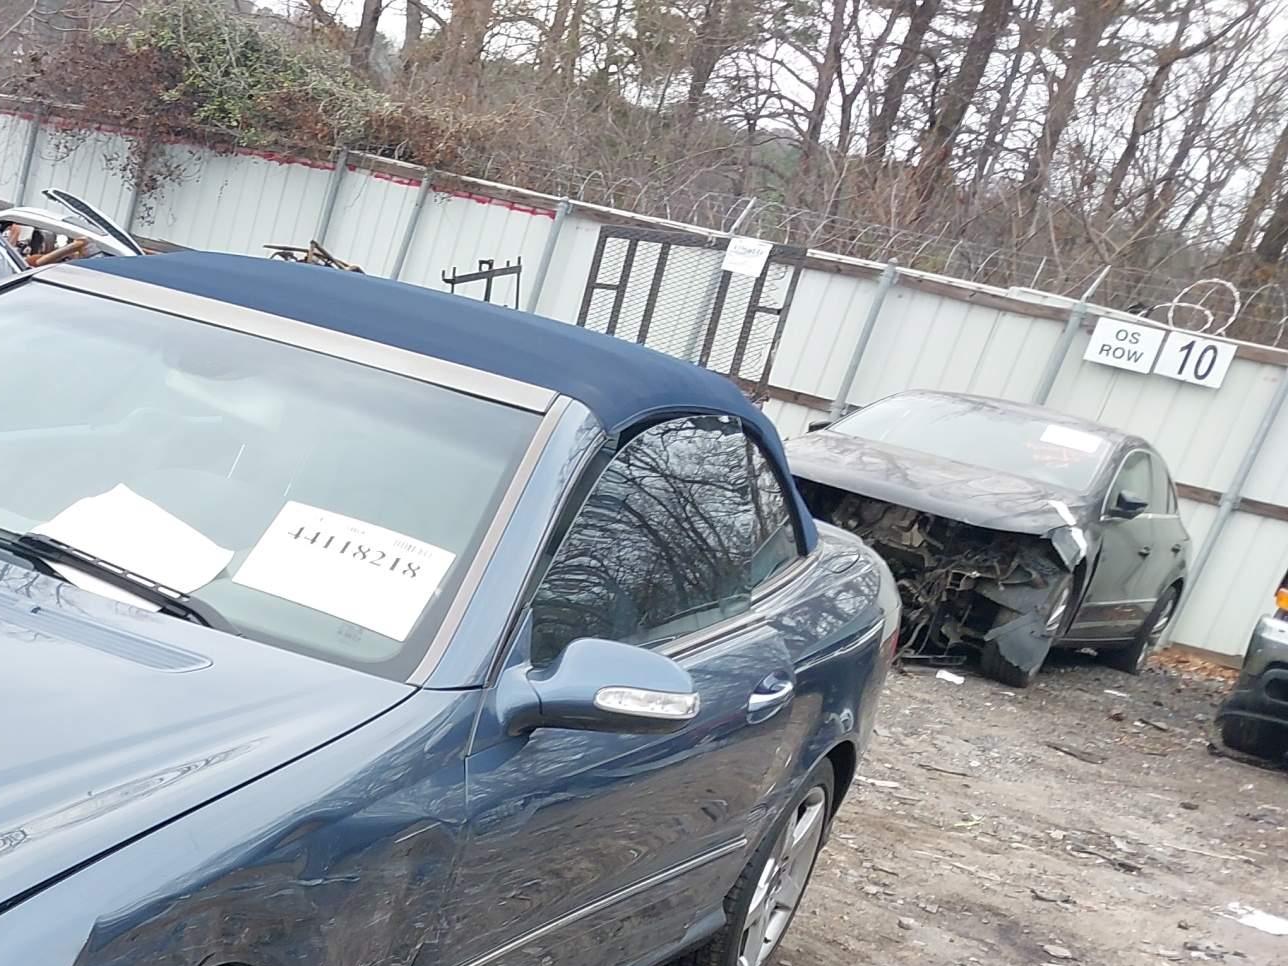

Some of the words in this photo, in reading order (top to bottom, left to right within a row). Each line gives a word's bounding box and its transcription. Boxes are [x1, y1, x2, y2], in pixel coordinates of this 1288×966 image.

[1115, 328, 1141, 345] OS
[1098, 343, 1144, 363] ROW
[1177, 340, 1218, 381] 10
[288, 525, 421, 578] 44118218
